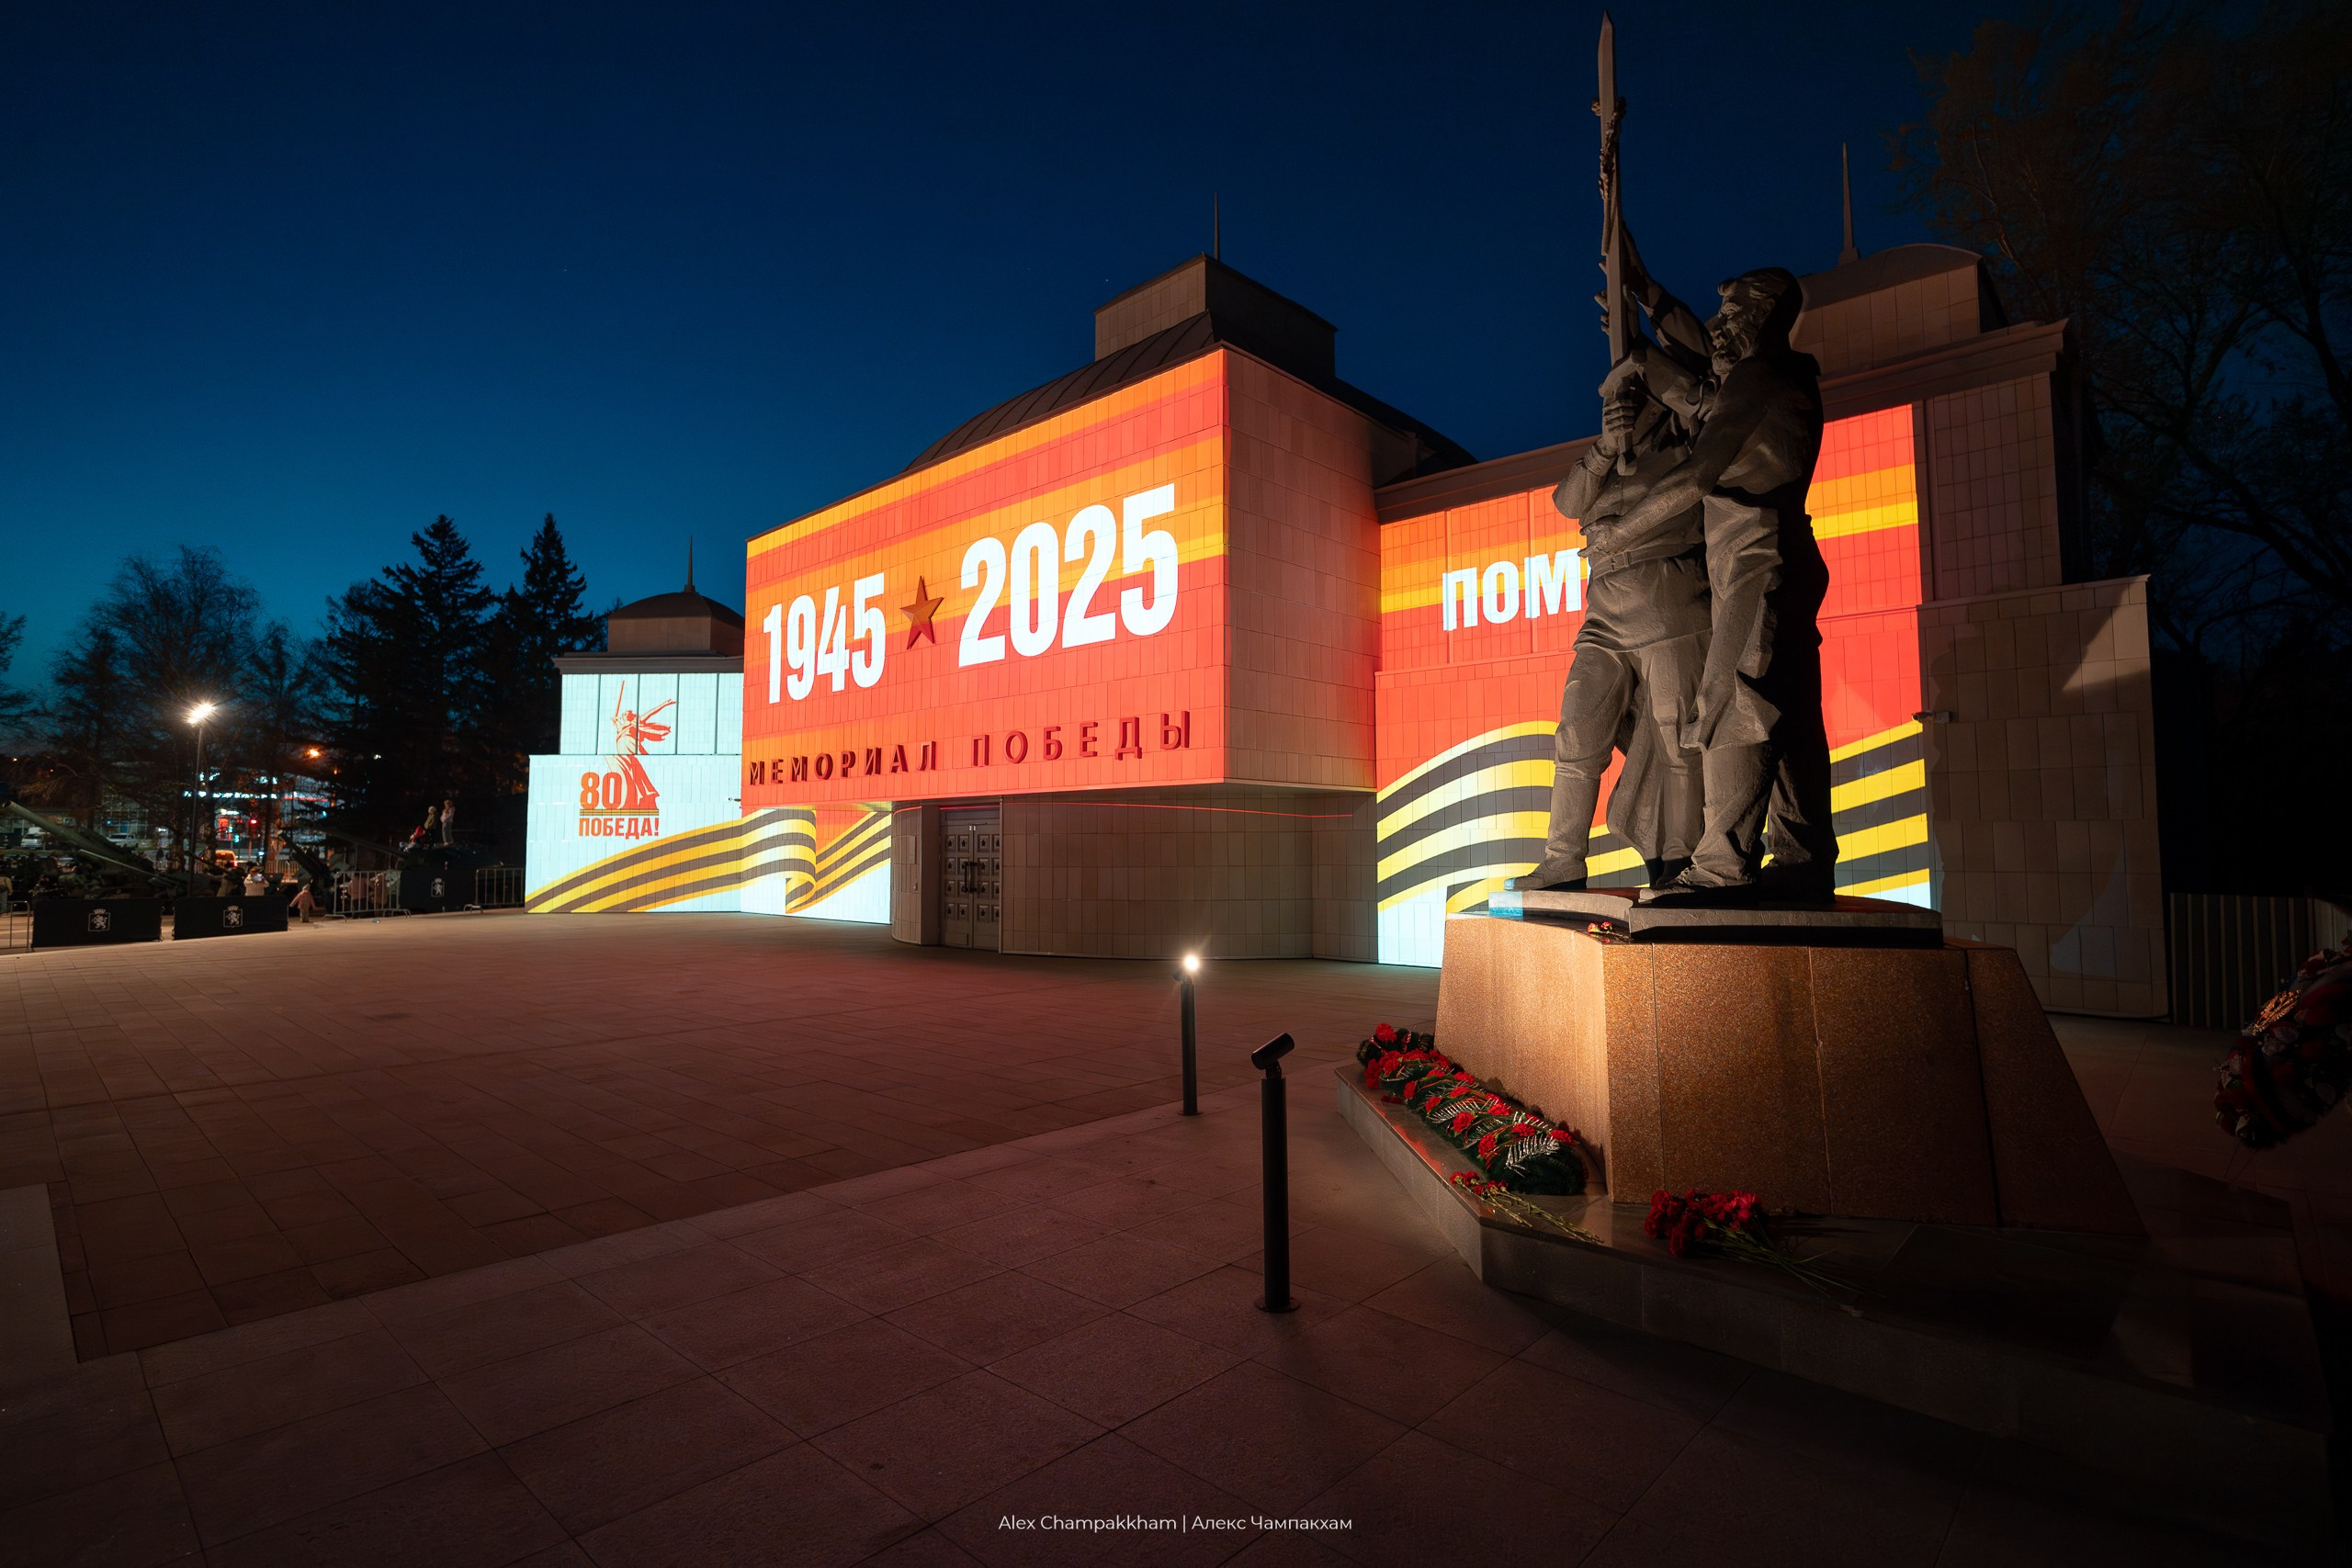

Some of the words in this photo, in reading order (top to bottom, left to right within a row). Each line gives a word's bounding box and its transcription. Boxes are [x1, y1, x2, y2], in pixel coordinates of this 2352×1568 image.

[763, 572, 885, 704] 1945
[957, 483, 1180, 668] 2025
[1442, 547, 1592, 631] ПОМ
[750, 740, 937, 786] МЕМОРИАЛ
[972, 711, 1191, 768] ПОБЕДЫ
[579, 817, 660, 840] ПОБЕДА!
[580, 772, 624, 810] 80
